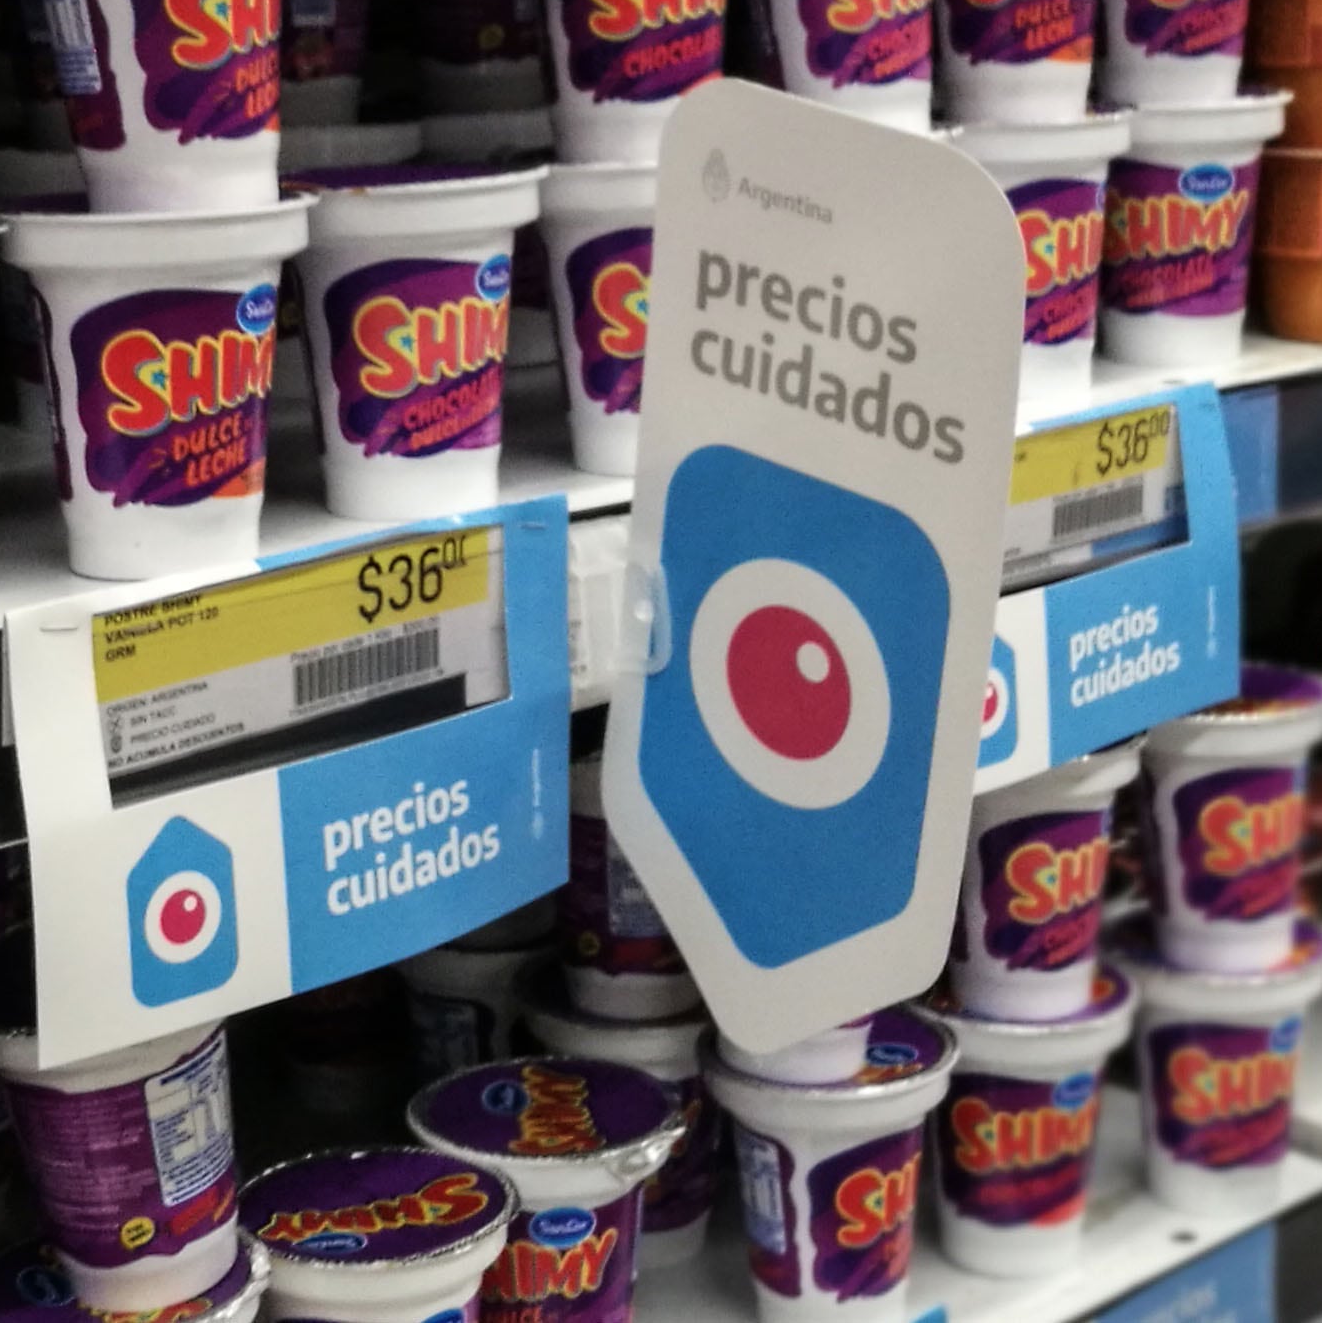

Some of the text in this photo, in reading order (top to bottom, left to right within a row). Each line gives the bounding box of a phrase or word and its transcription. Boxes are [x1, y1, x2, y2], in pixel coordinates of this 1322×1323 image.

[738, 178, 834, 224] Argentina
[1015, 209, 1104, 297] SHI
[695, 249, 918, 364] precios
[101, 329, 275, 436] SHIM
[353, 295, 509, 398] SHIM
[690, 329, 966, 465] cuidados
[172, 411, 243, 462] DULCE
[186, 436, 247, 487] LECHE
[105, 603, 159, 627] POSTRE
[168, 613, 196, 630] POT
[358, 548, 443, 624] $36
[105, 644, 137, 662] GRM
[1069, 603, 1159, 672] precios
[1070, 642, 1181, 708] cuidados
[323, 777, 470, 871] precios
[327, 821, 500, 917] cuidados
[1006, 837, 1109, 924] SHI
